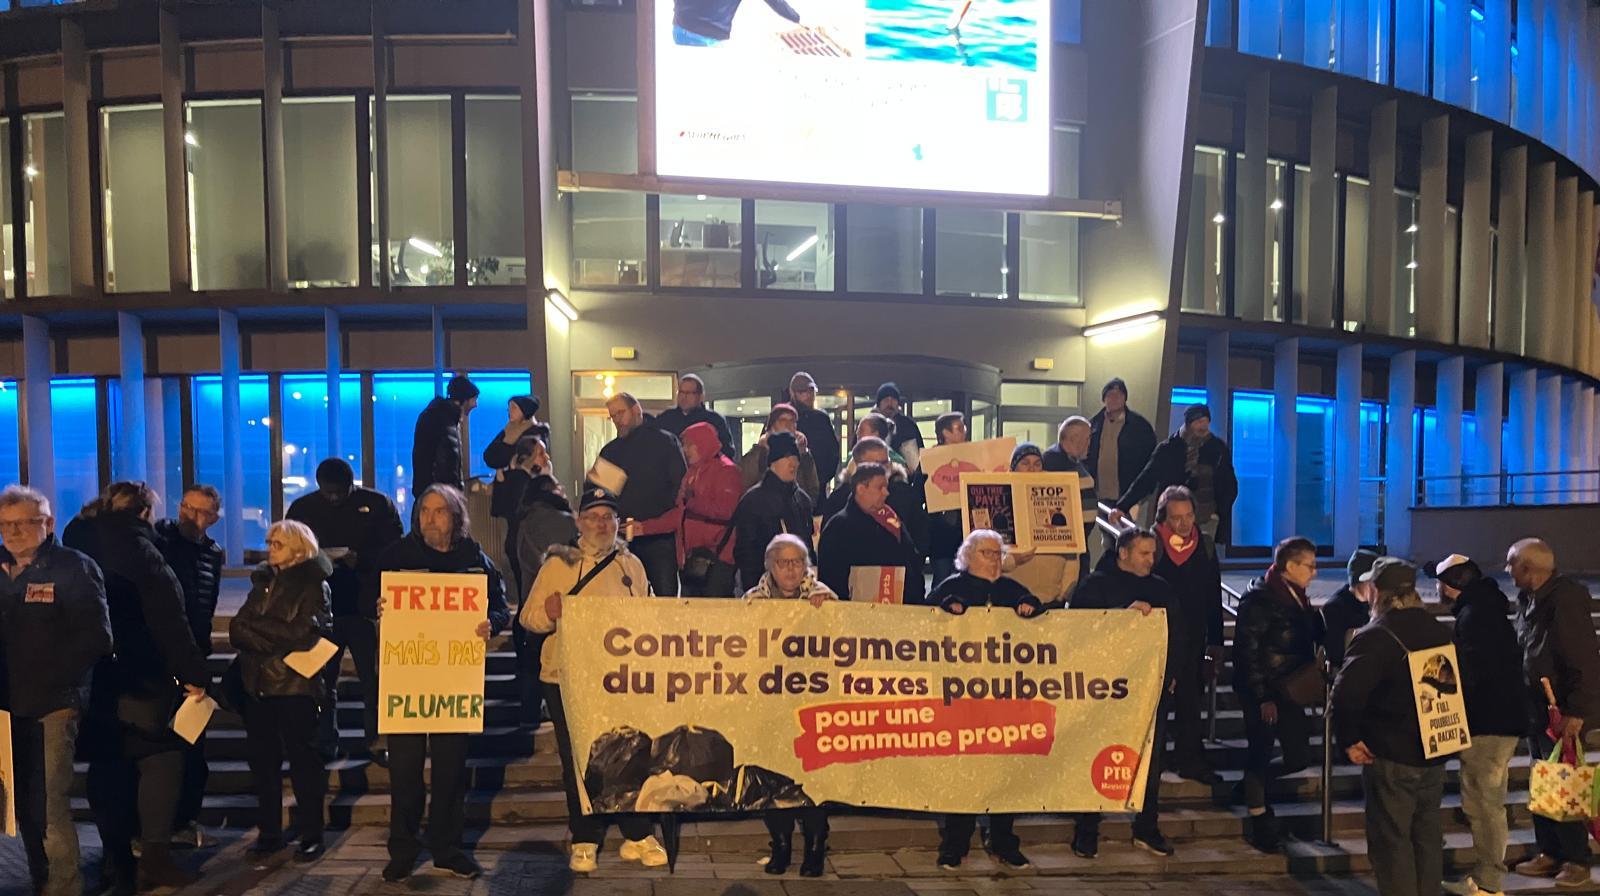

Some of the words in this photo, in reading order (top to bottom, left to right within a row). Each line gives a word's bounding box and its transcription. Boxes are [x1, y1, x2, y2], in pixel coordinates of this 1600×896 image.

[1031, 486, 1064, 497] STOP
[387, 585, 480, 611] TRIER
[447, 639, 484, 666] PAS
[603, 627, 748, 657] Contre
[602, 663, 655, 694] du
[666, 661, 748, 703] prix
[758, 664, 830, 695] des
[842, 673, 929, 696] taxes
[942, 670, 1129, 707] poubelles
[387, 694, 484, 718] PLUMER
[815, 709, 879, 734] pour
[885, 706, 935, 725] une
[1429, 712, 1461, 730] POUBELLES
[816, 729, 953, 753] commune
[958, 722, 1047, 752] propre
[1437, 728, 1458, 742] RACKET
[1103, 765, 1132, 780] PTB
